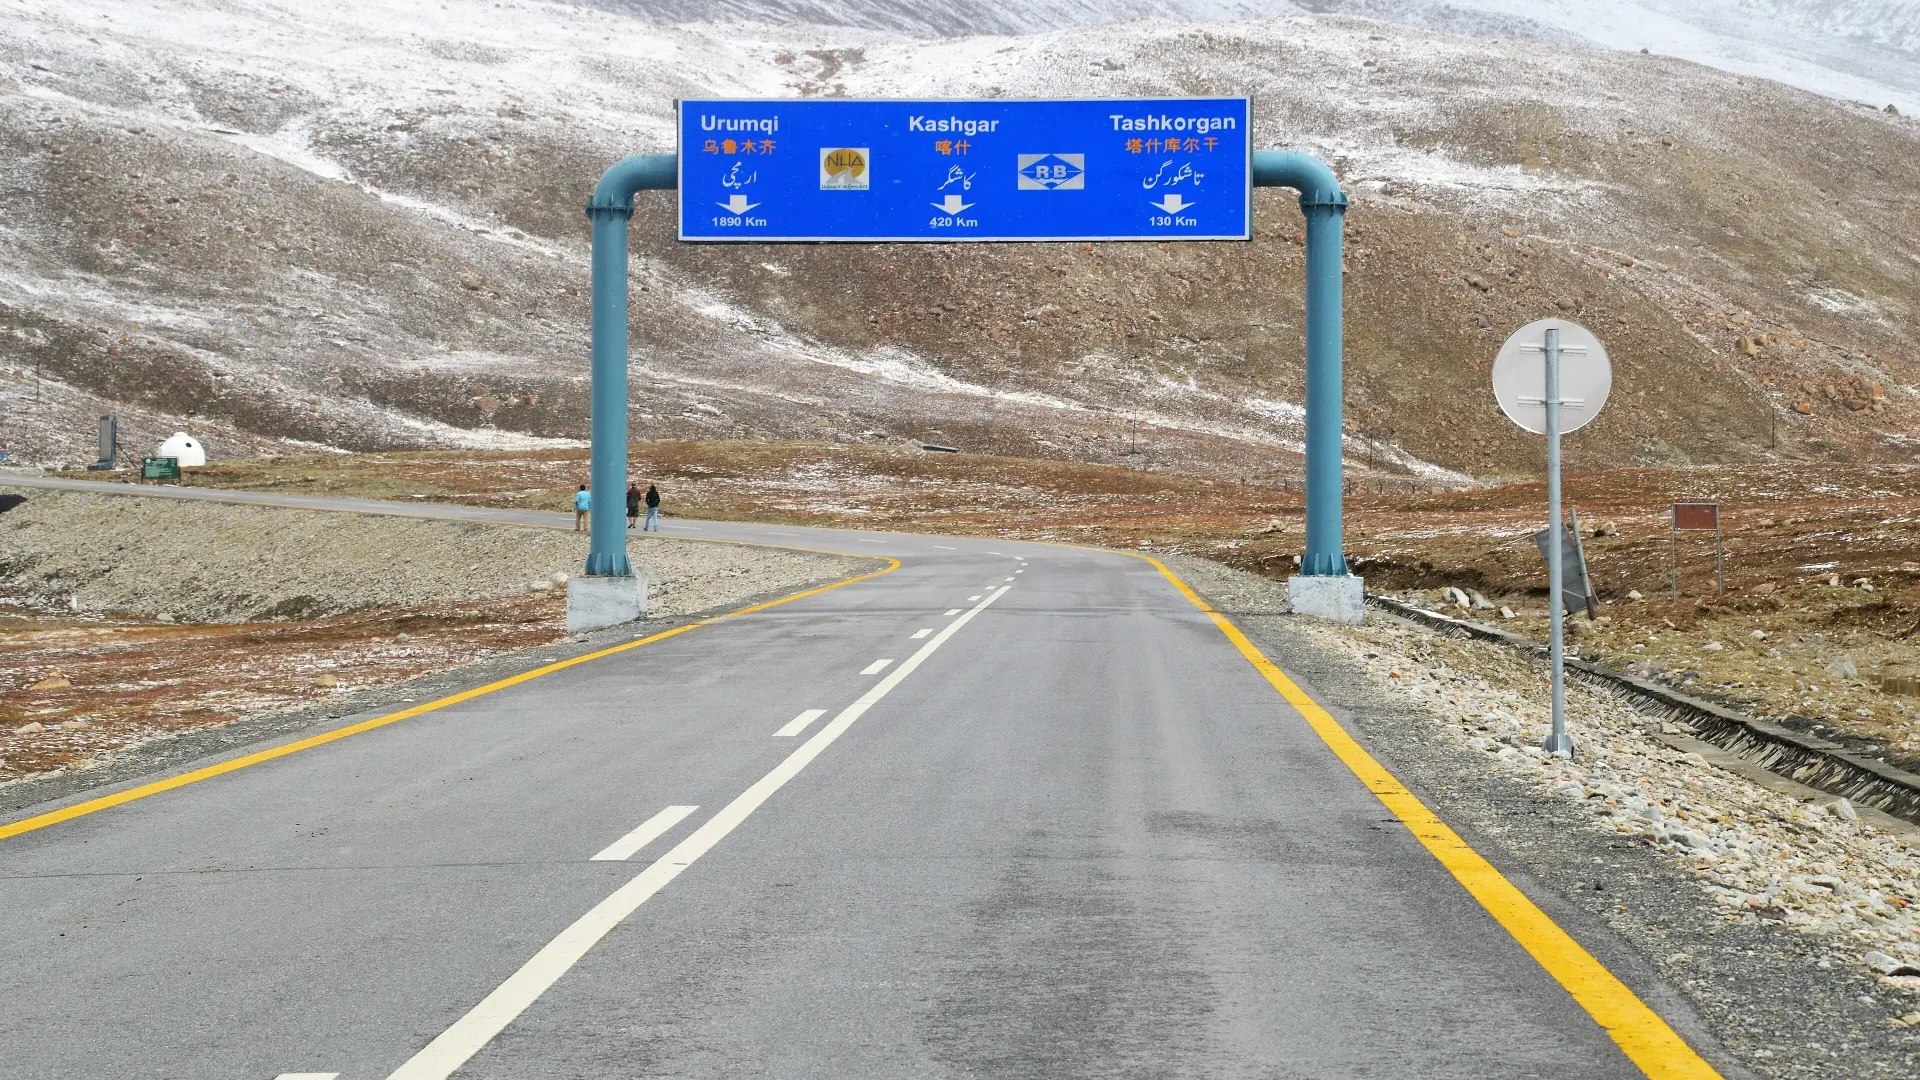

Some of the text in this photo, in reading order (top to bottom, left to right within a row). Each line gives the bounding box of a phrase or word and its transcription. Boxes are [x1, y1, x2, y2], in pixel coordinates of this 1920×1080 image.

[701, 115, 779, 135] Urumqi
[908, 115, 1000, 136] Kashgar
[1109, 114, 1237, 134] Tashkorgan
[702, 138, 777, 155] 乌鲁木齐
[935, 139, 972, 156] 喀什
[1125, 137, 1219, 154] 塔什库尔干
[711, 216, 767, 228] 1890 Km
[929, 217, 978, 229] 420 Km
[1149, 216, 1197, 227] 130 Km
